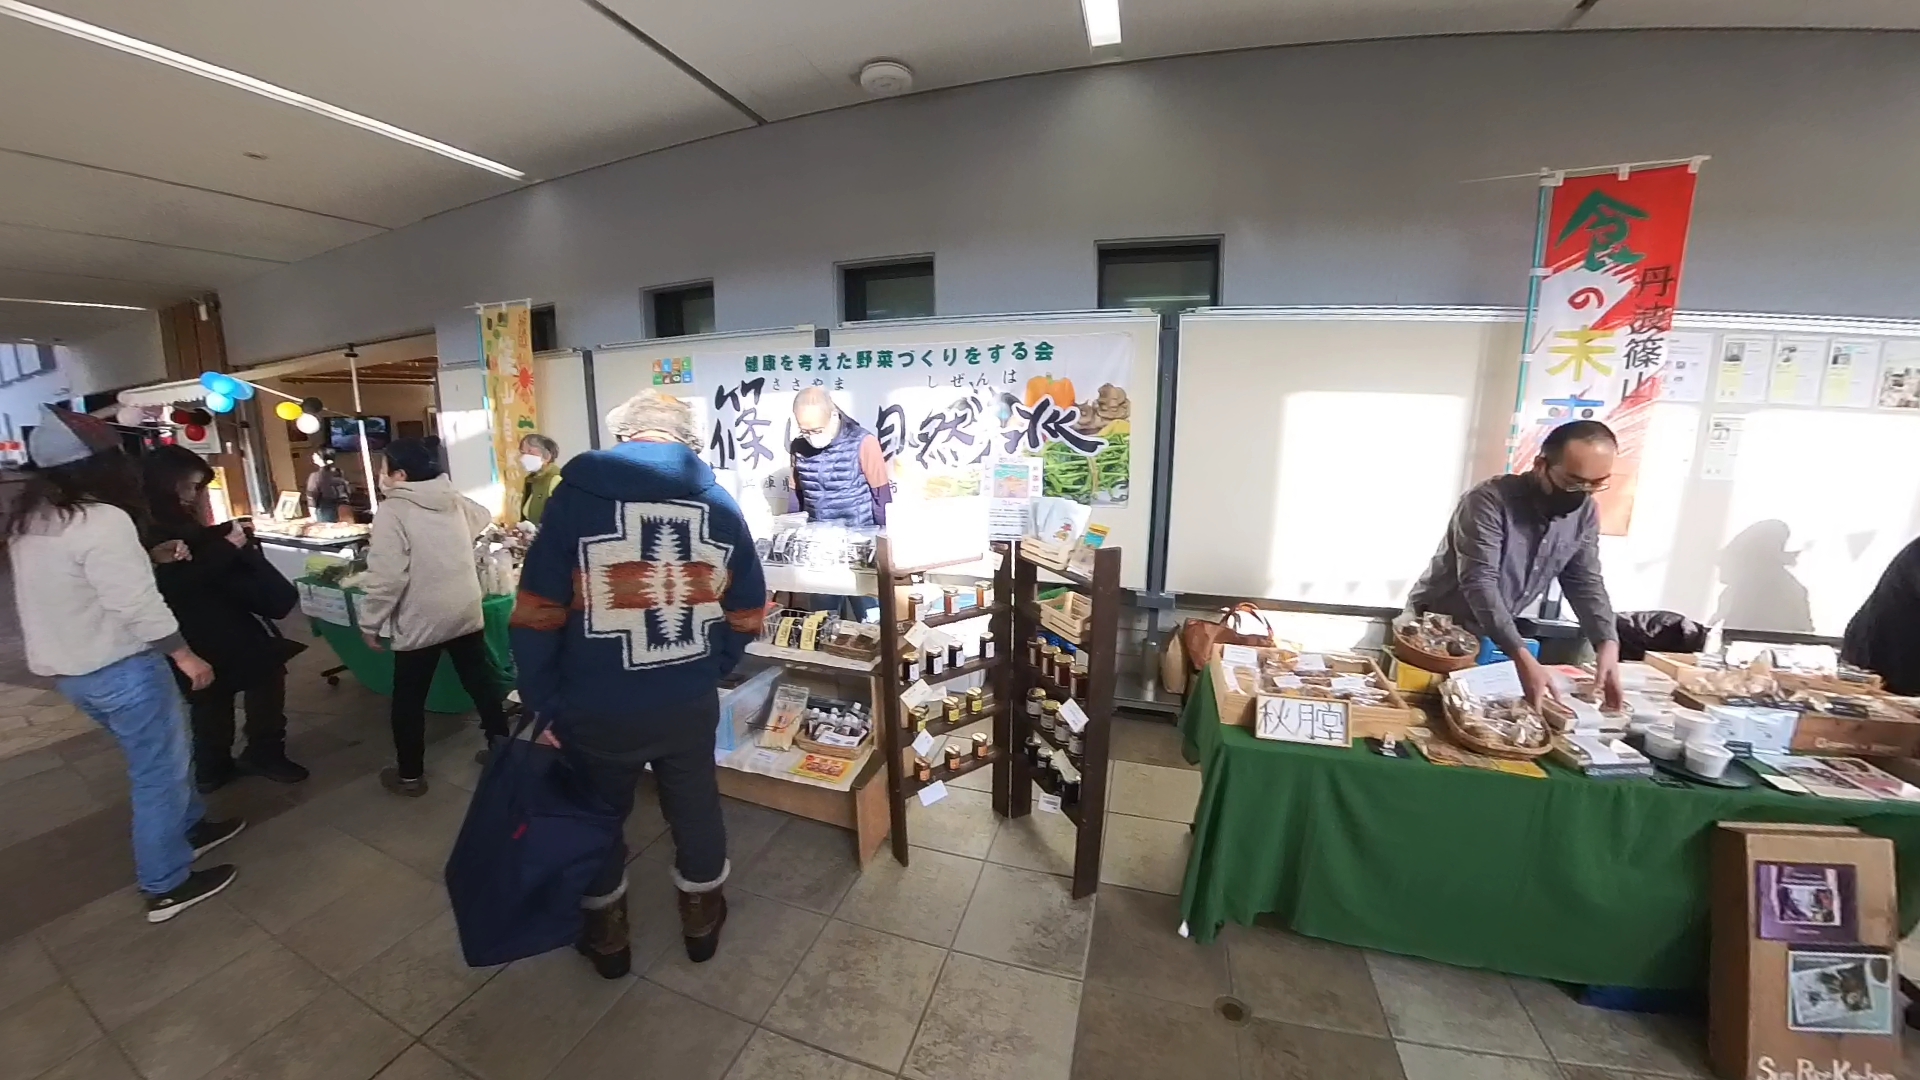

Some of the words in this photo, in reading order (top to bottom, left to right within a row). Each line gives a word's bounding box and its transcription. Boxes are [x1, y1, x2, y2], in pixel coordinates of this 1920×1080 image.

[744, 341, 1055, 373] 健康を考えた野菜づくりをする会
[772, 376, 845, 391] ささやま
[928, 369, 1017, 388] しぜんは
